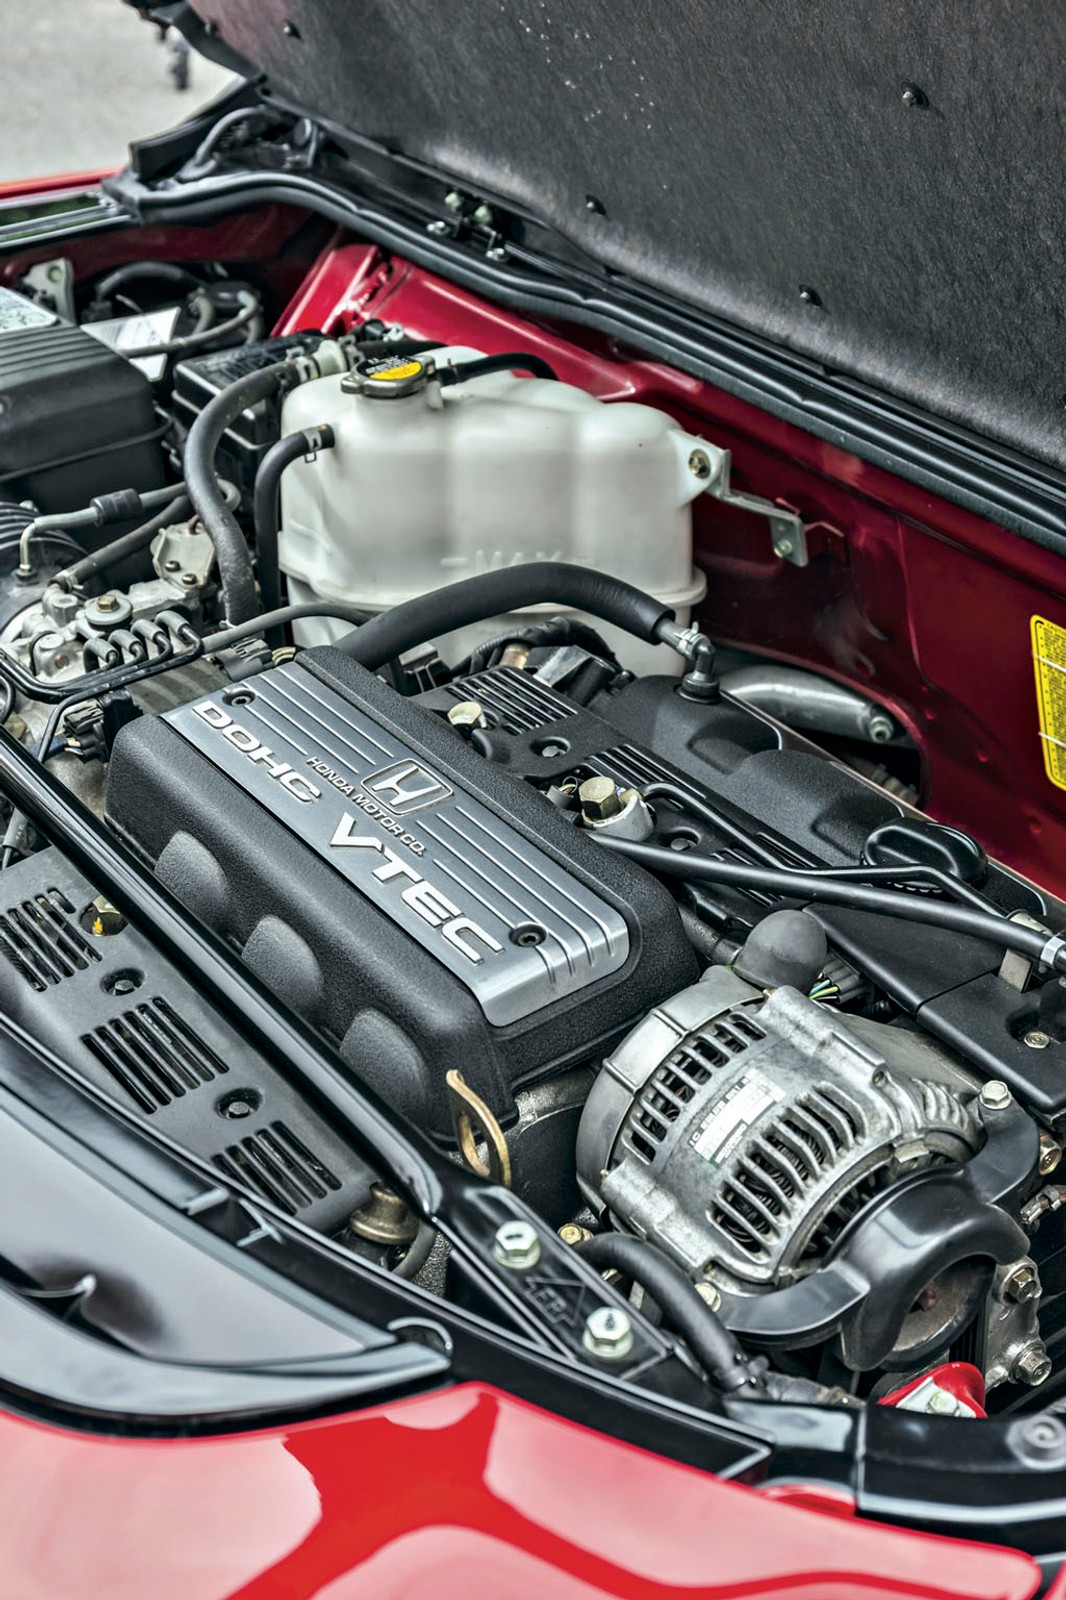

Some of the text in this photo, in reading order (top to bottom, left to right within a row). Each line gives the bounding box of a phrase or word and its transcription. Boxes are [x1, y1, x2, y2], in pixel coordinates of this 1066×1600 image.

[191, 700, 322, 803] DOHC
[306, 756, 427, 857] HONDA MOTOR CO.
[330, 811, 506, 965] VTEC
